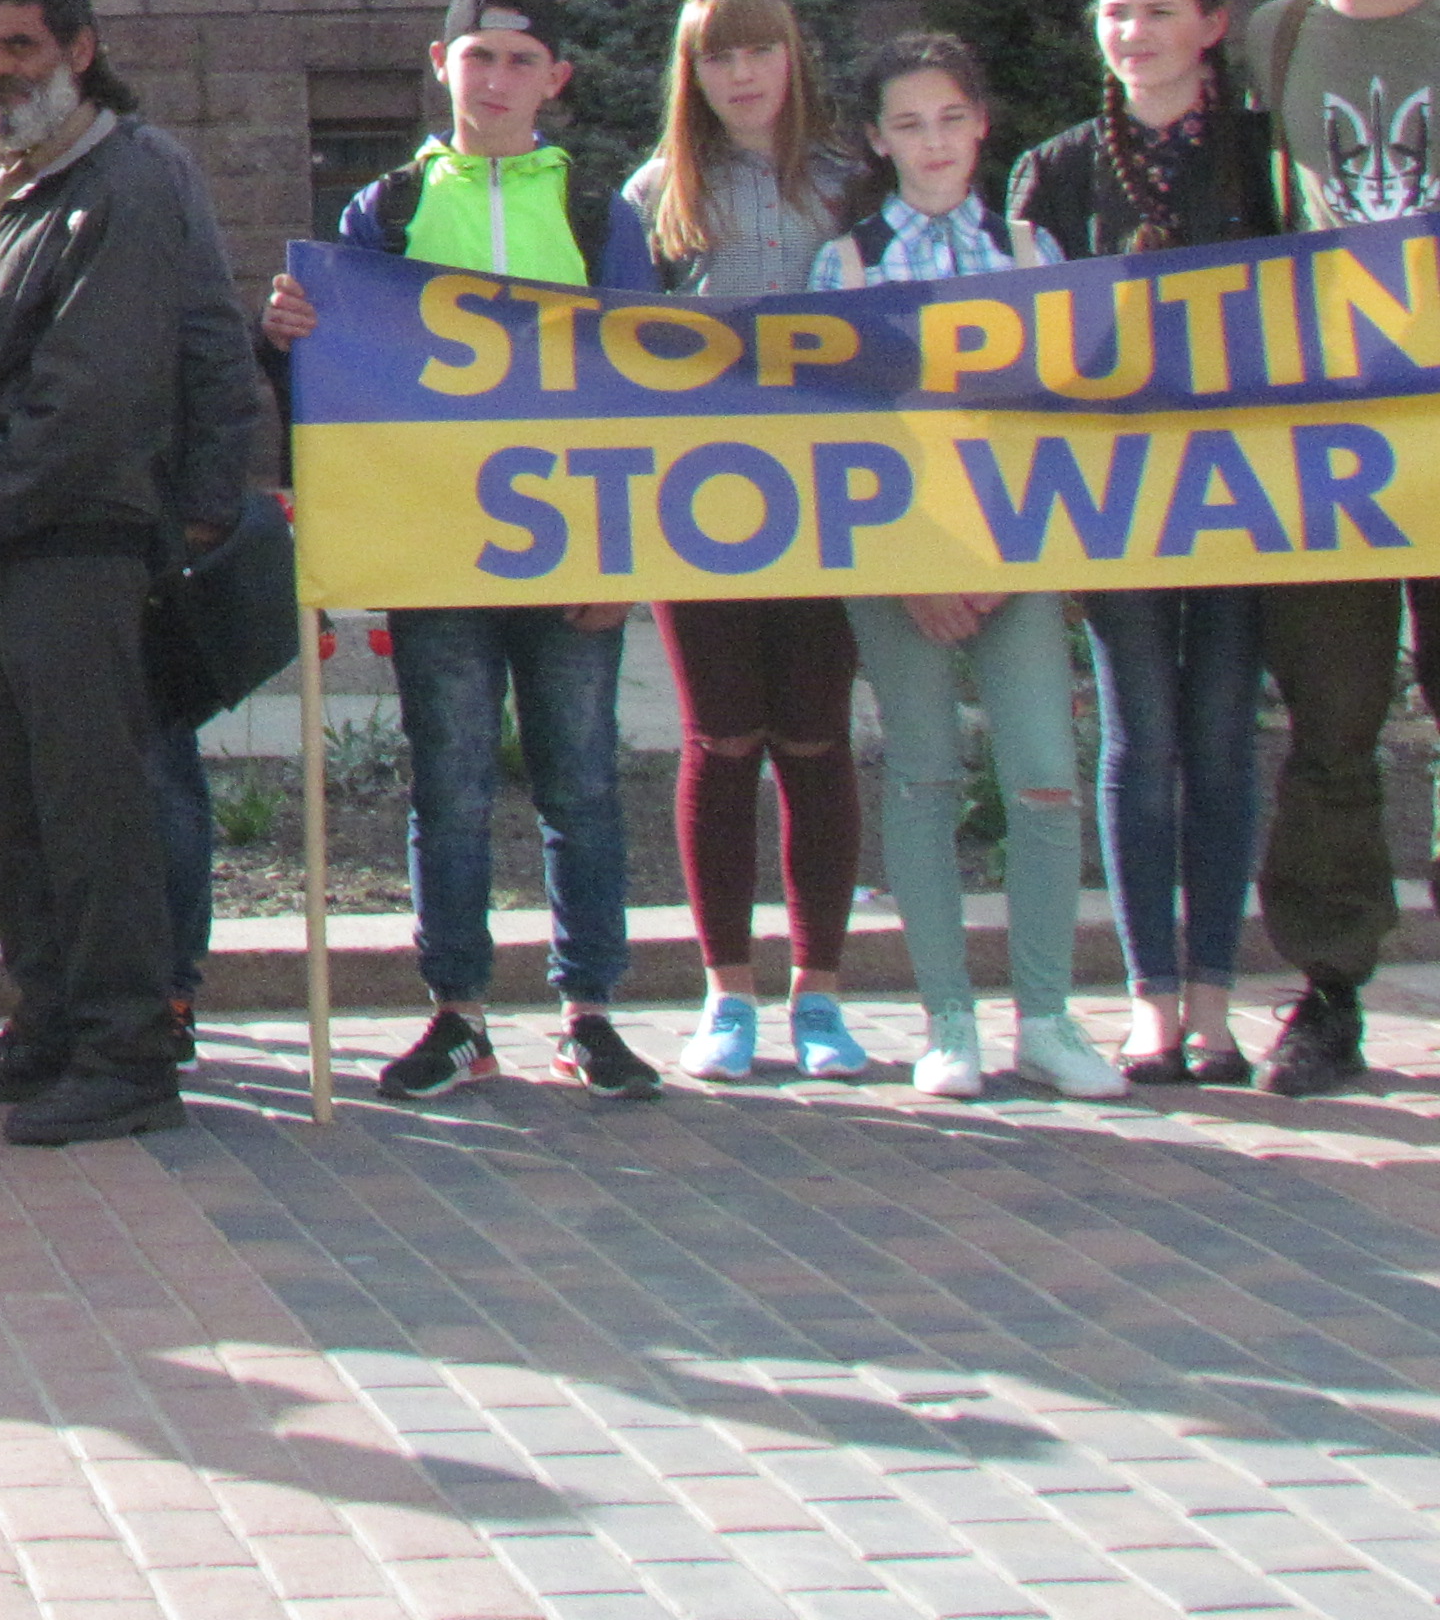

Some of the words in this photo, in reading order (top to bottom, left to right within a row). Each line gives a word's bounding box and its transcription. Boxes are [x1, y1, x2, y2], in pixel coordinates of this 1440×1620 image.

[418, 274, 861, 397] STOP
[920, 235, 1440, 400] PUTIN
[474, 440, 914, 580] STOP
[952, 423, 1414, 564] WAR
